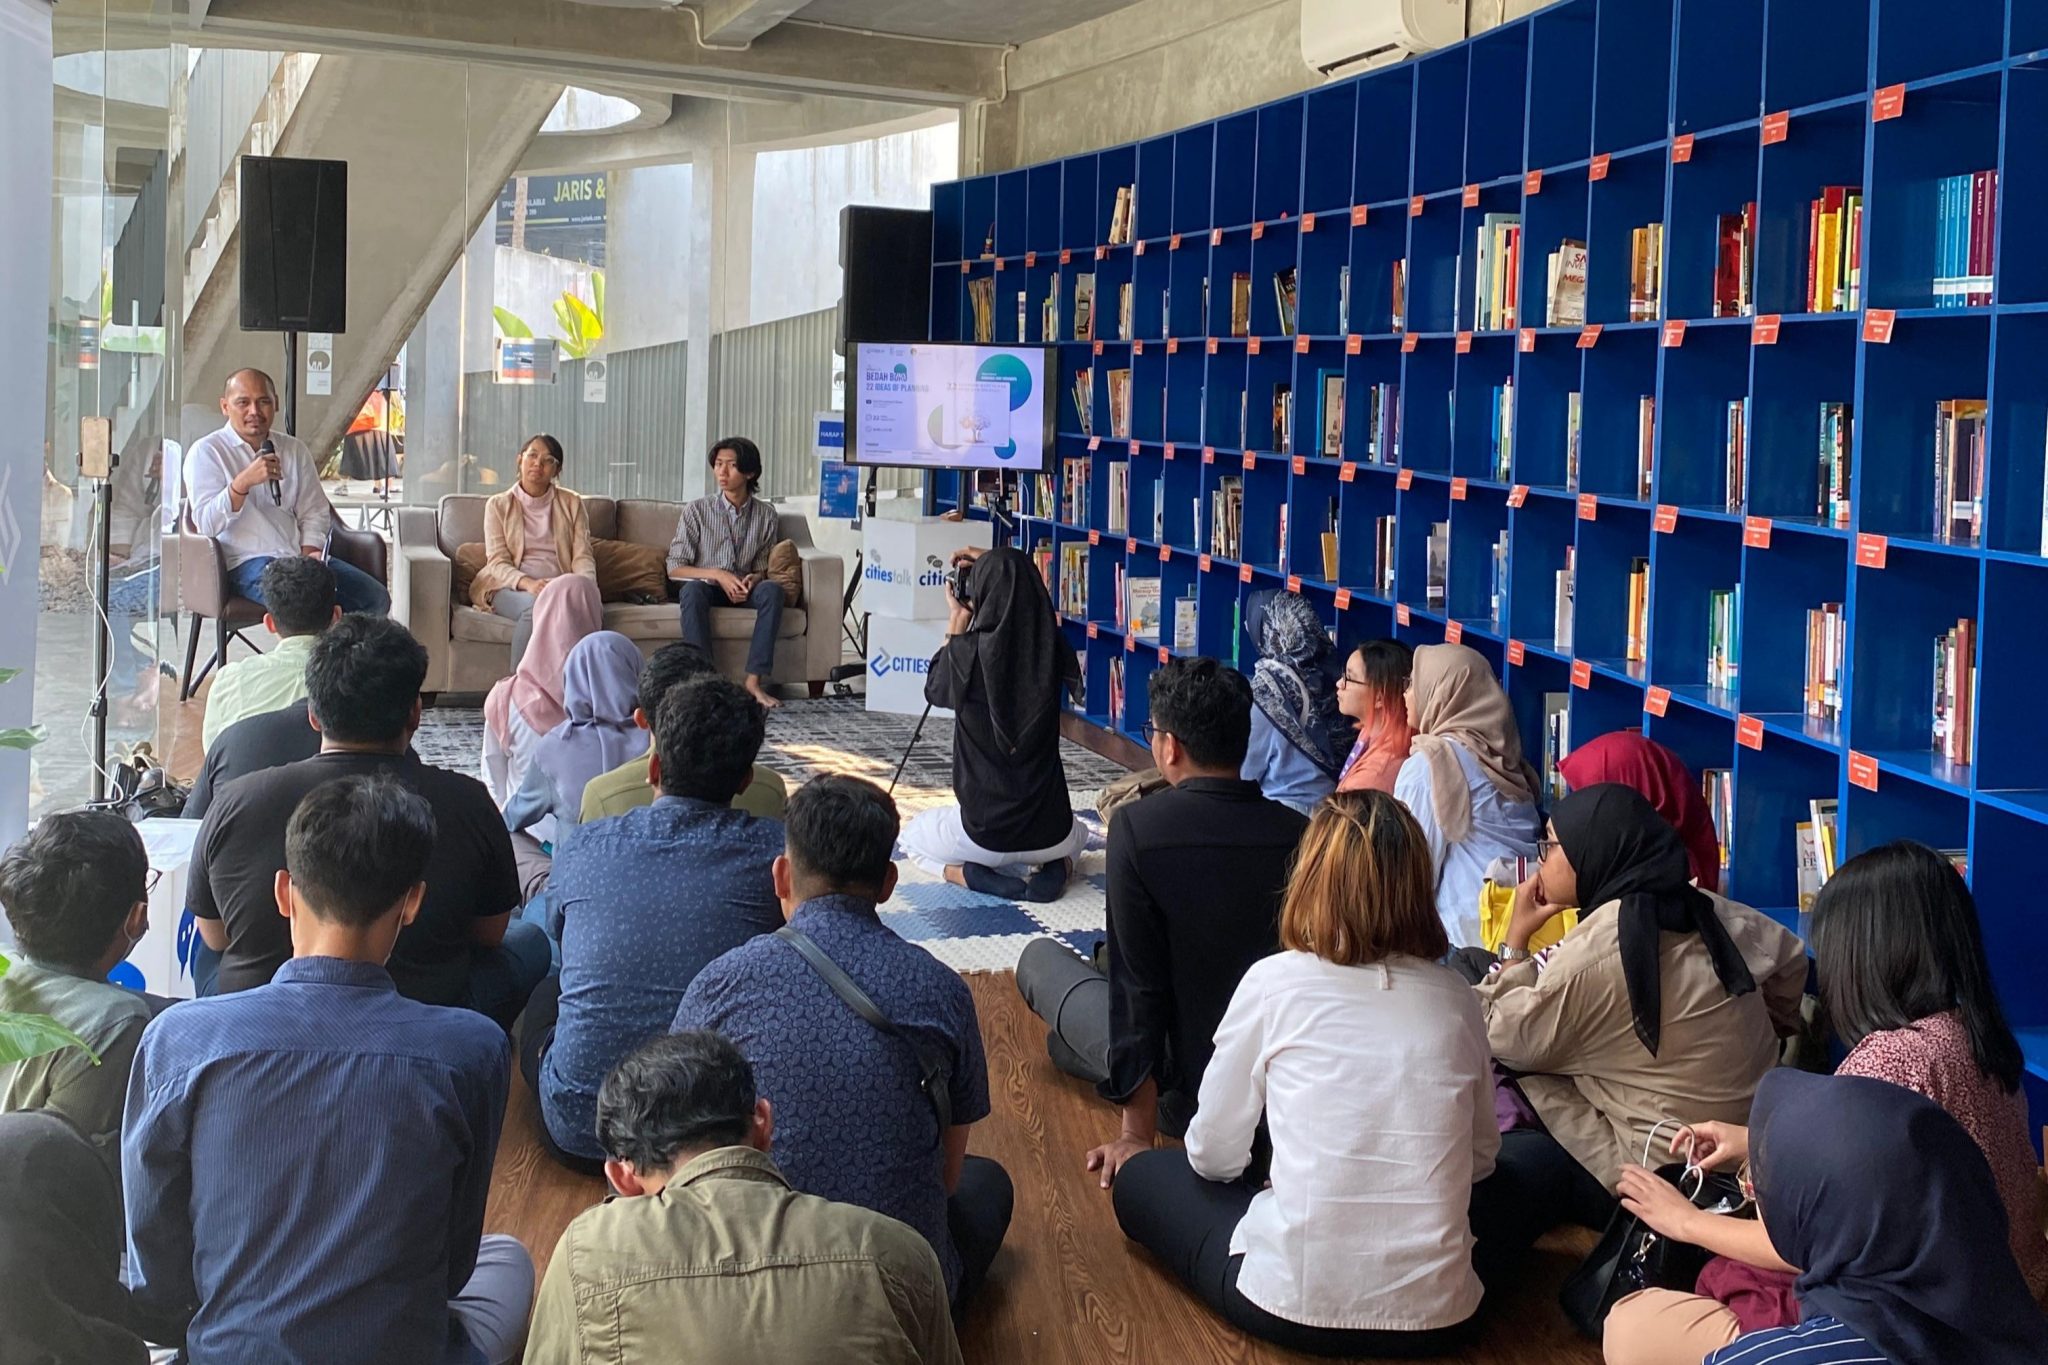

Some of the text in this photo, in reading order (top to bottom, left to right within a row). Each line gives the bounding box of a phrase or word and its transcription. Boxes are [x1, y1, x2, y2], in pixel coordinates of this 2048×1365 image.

[553, 178, 605, 202] JARIS &
[866, 371, 888, 381] BEDAH
[892, 656, 930, 674] CITIES
